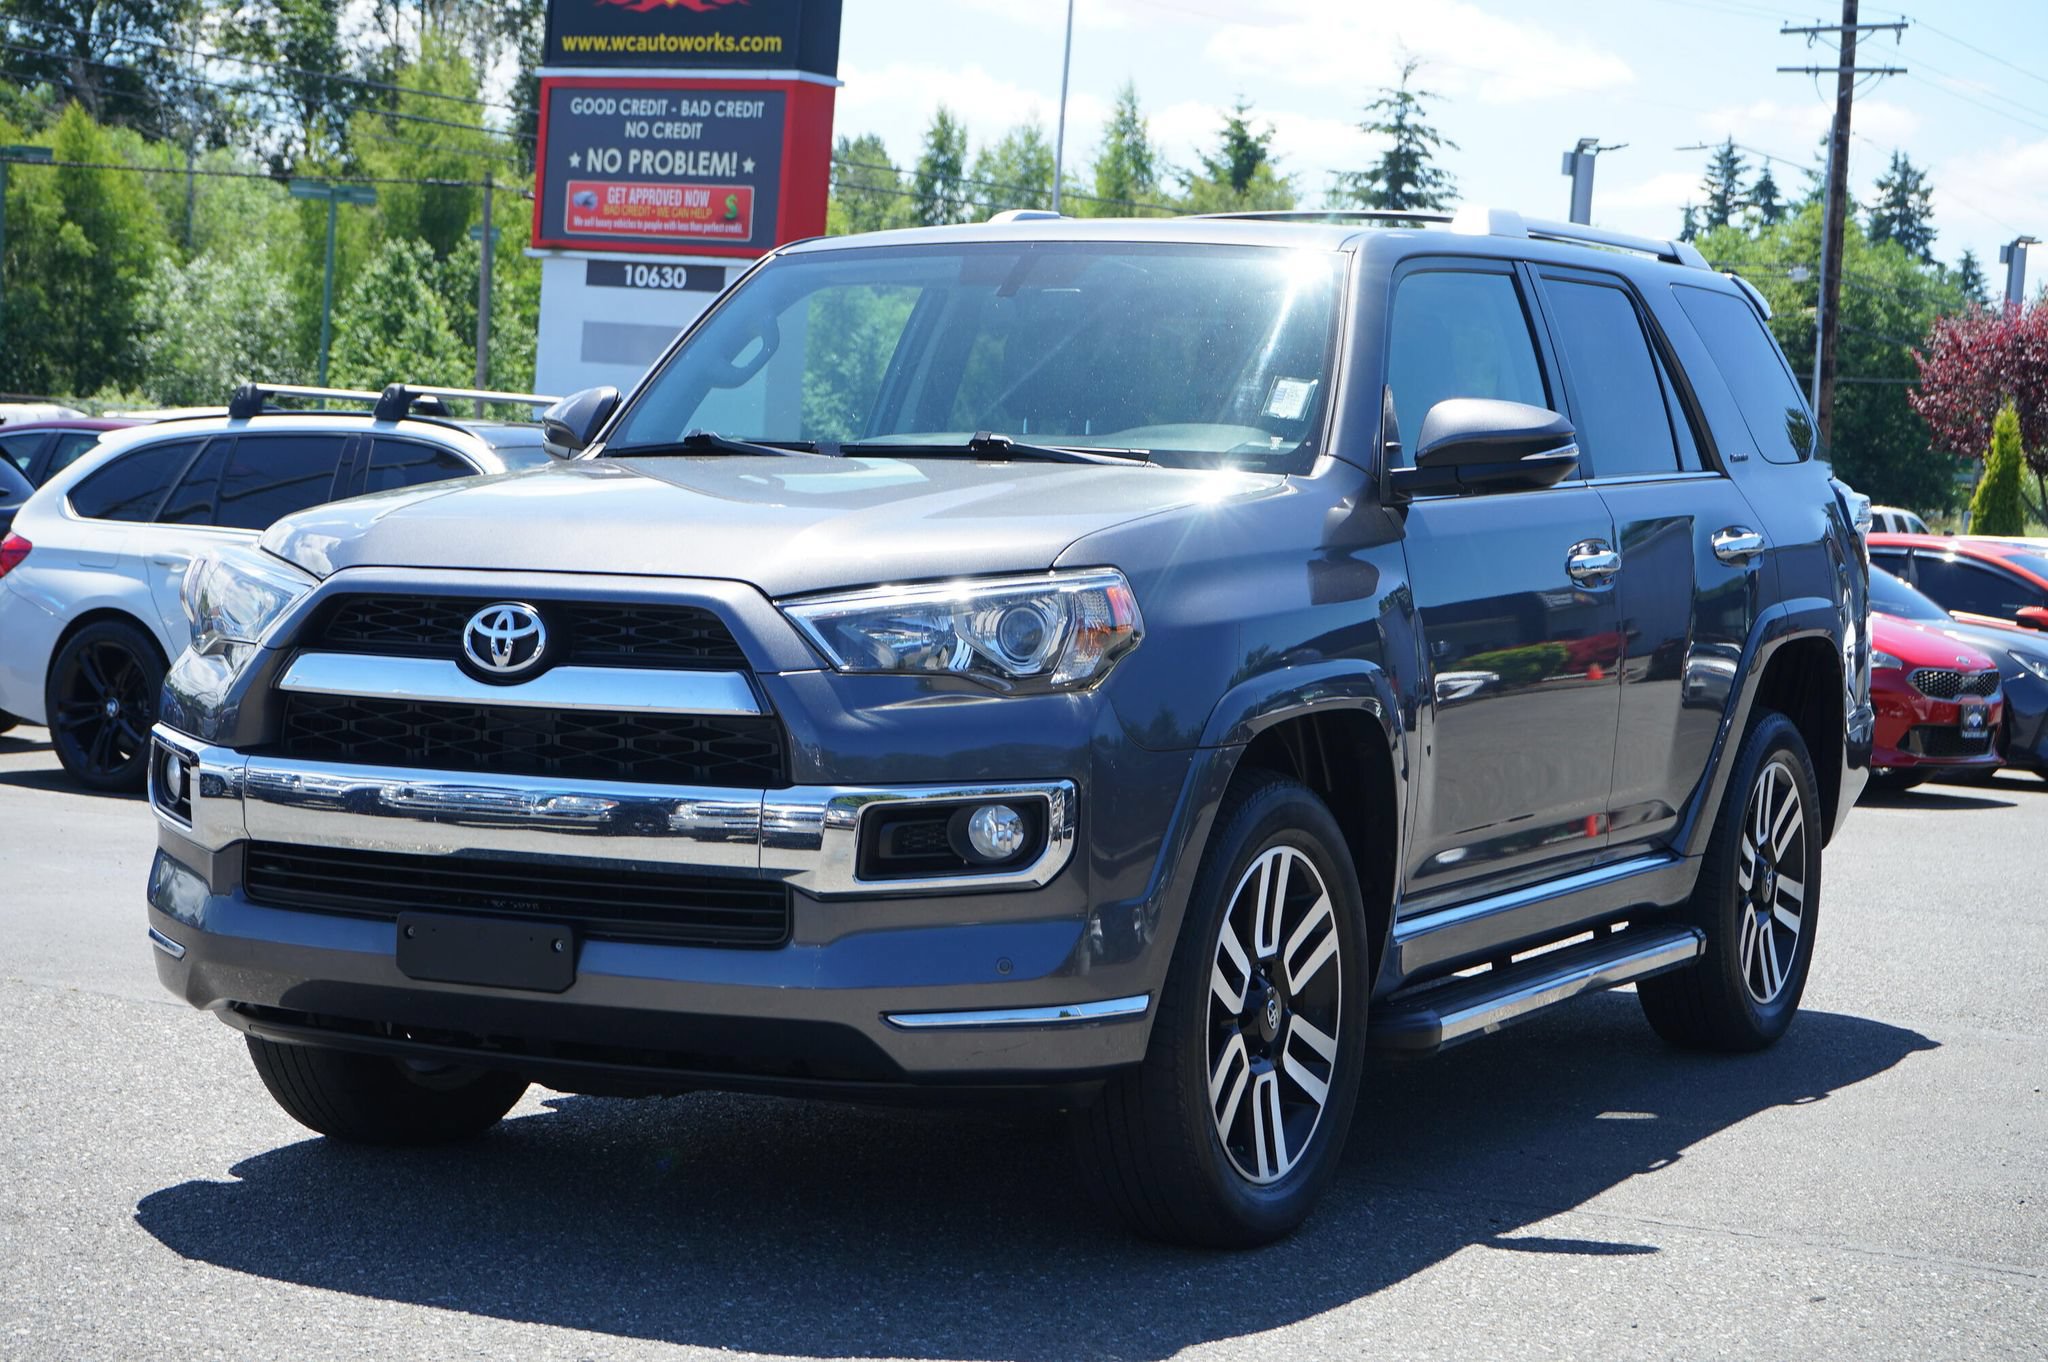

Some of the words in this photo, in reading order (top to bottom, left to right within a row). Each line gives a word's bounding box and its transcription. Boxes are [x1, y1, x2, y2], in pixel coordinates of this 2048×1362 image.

[562, 32, 783, 53] www.wcautoworks.com
[570, 97, 616, 115] GOOD
[619, 98, 669, 116] CREDIT
[681, 99, 711, 117] BAD
[714, 100, 765, 118] CREDIT
[624, 121, 649, 138] NO
[652, 122, 703, 139] CREDIT
[586, 147, 622, 174] NO
[628, 148, 738, 177] PROBLEM!
[608, 186, 627, 204] GET
[630, 188, 682, 207] APPROVED
[685, 189, 711, 208] NOW
[603, 204, 620, 215] BAD
[621, 205, 651, 217] CREDIT
[671, 207, 689, 218] CAN
[691, 208, 712, 220] HELP
[624, 264, 687, 288] 10630
